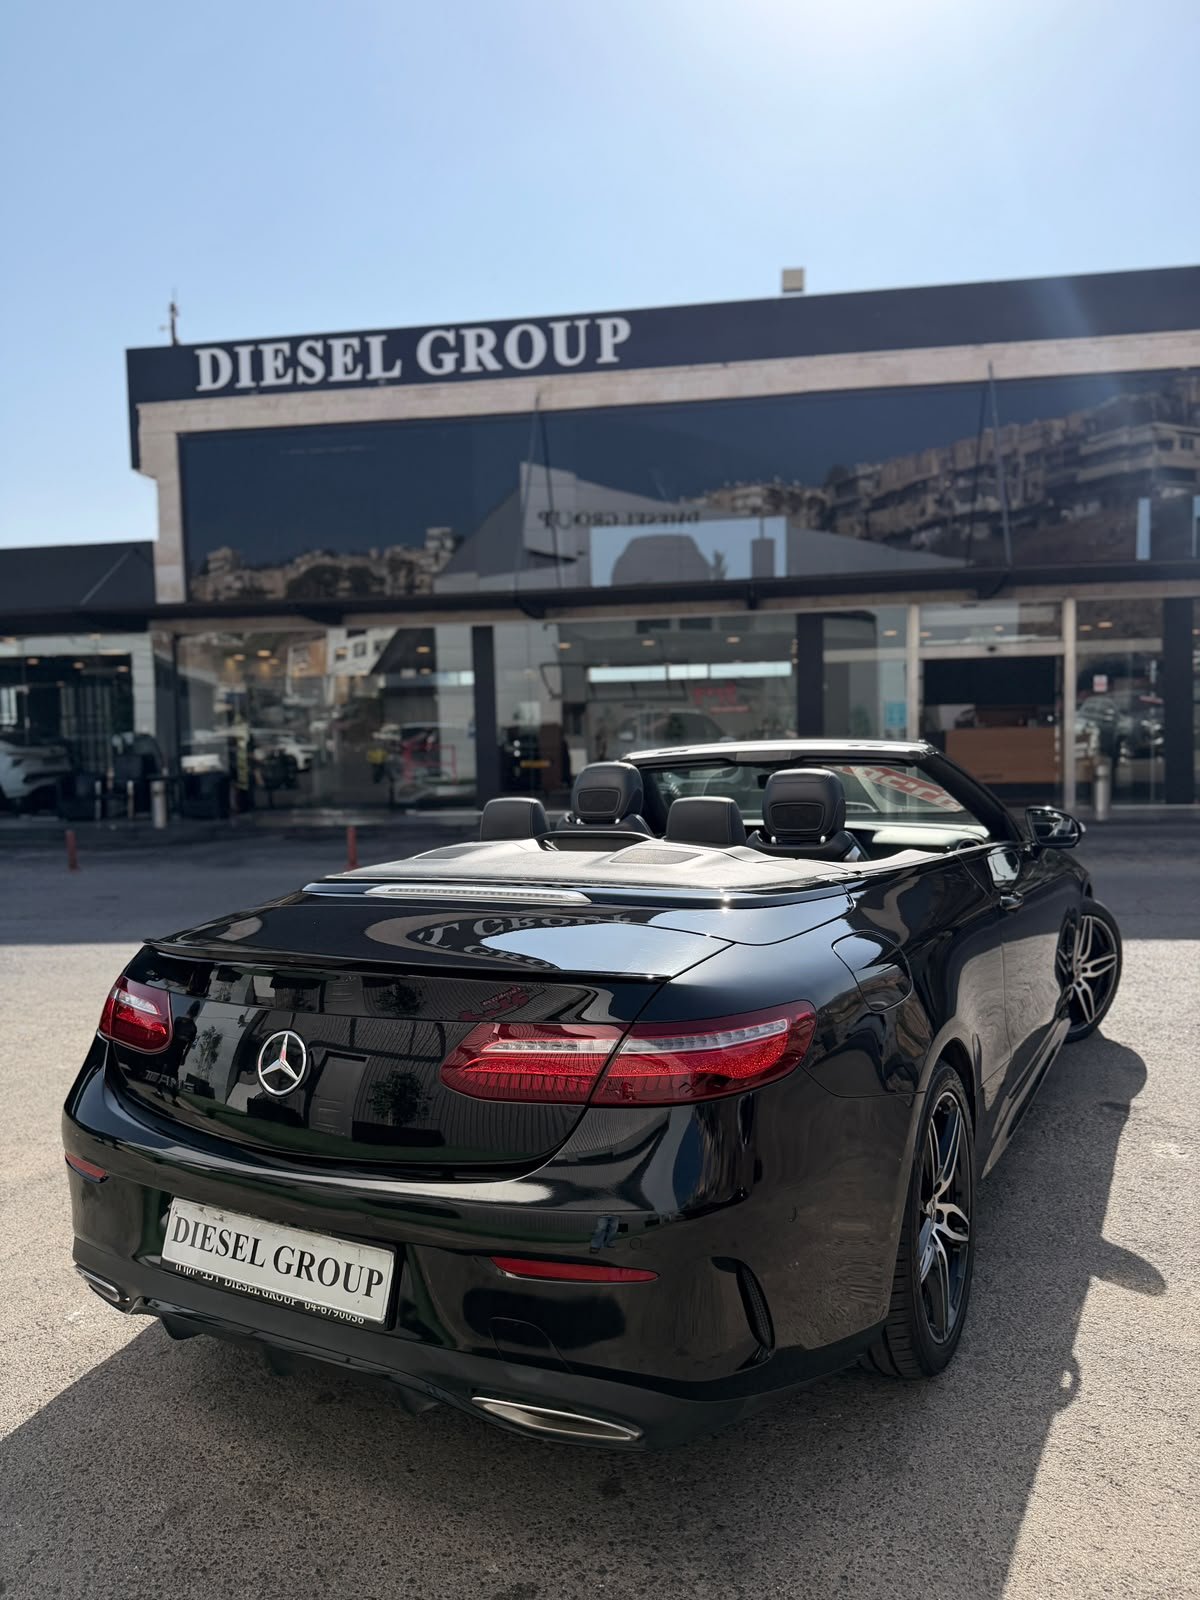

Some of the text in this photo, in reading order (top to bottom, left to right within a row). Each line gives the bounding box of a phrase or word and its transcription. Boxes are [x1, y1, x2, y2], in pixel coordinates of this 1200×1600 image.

[195, 317, 632, 392] DIESEL GROUP
[171, 1215, 384, 1298] DIESEL GROUP
